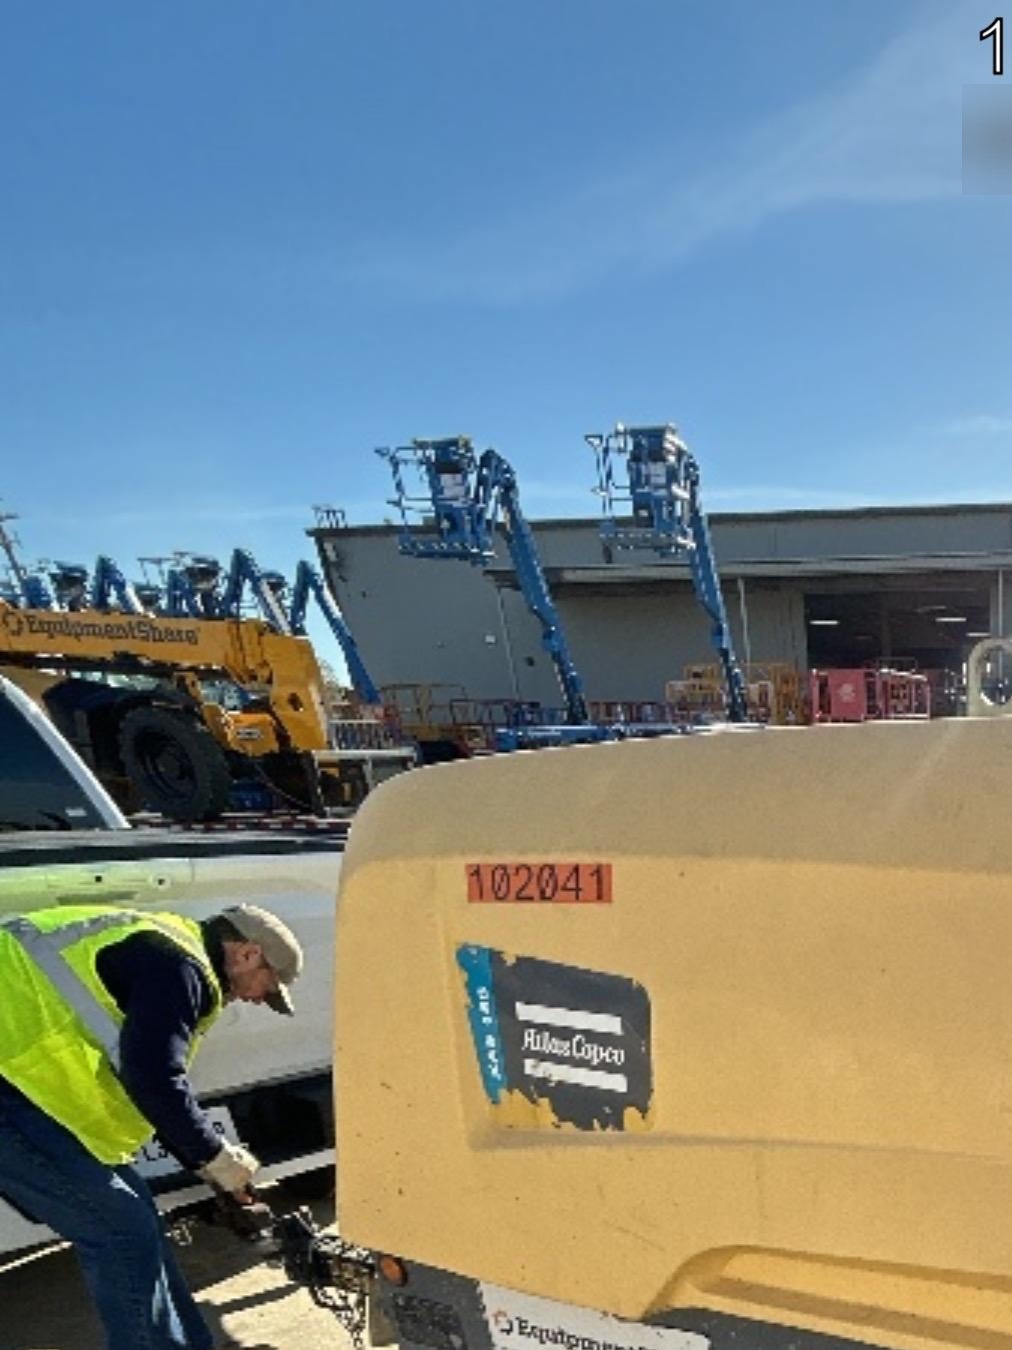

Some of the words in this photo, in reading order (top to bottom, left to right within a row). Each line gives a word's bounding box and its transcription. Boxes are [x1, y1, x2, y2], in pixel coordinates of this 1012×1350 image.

[24, 614, 199, 645] EquipmentShare
[469, 863, 605, 901] 102041
[521, 1028, 570, 1056] Atlas
[572, 1034, 625, 1066] Copco
